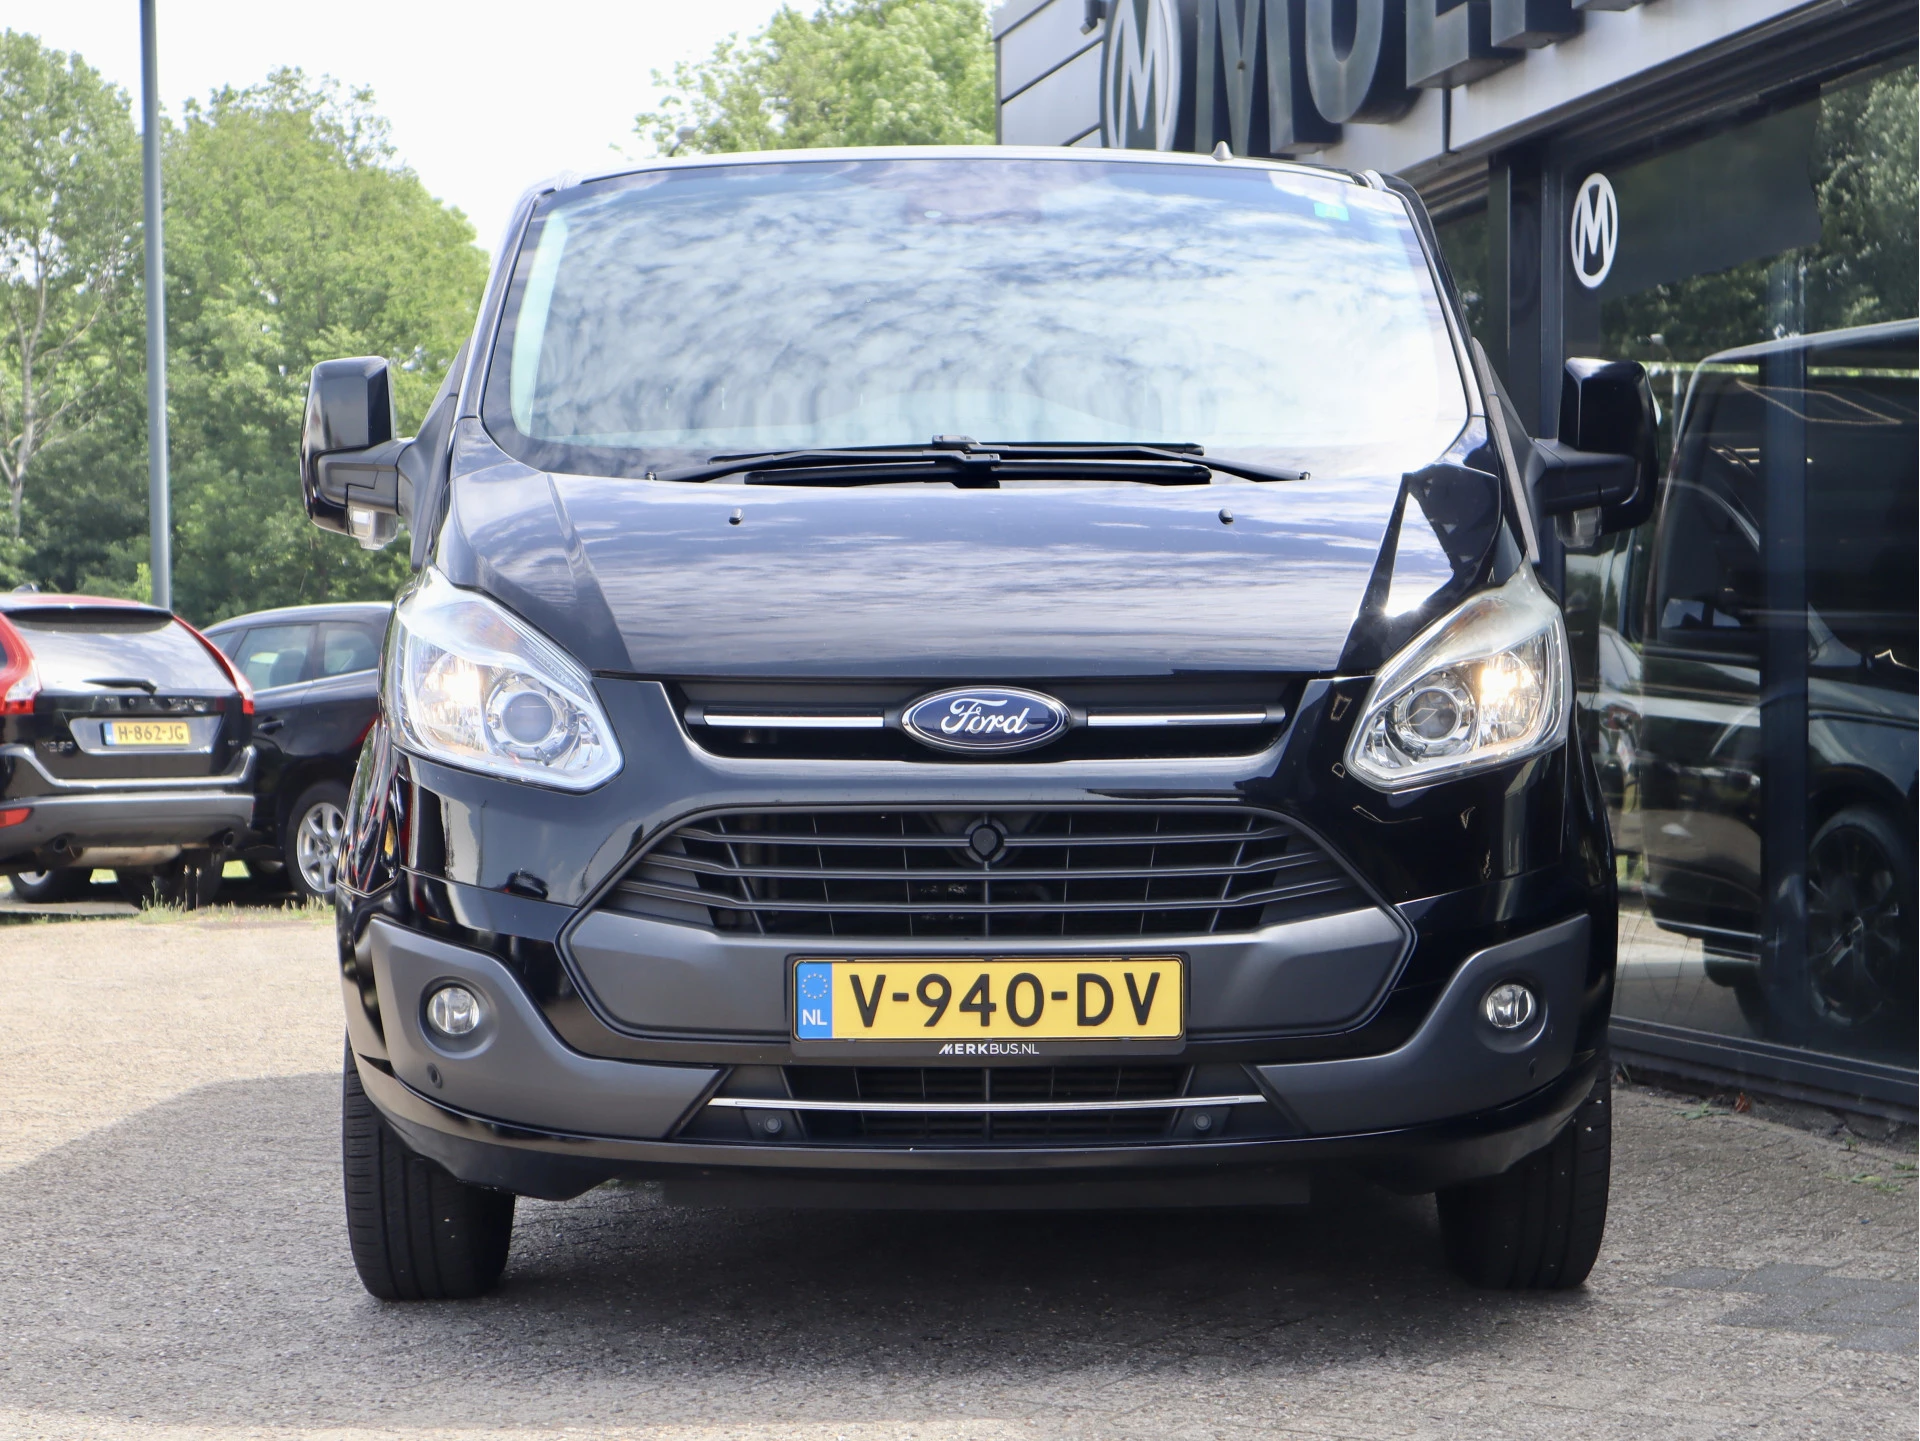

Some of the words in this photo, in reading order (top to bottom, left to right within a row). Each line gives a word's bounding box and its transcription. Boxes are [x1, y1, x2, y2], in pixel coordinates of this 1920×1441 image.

[940, 698, 1030, 734] Ford
[118, 725, 184, 741] H-862-JG
[849, 972, 1160, 1028] V-940-DV
[802, 1008, 828, 1026] NL
[938, 1043, 1040, 1055] MERKBUS.NL
